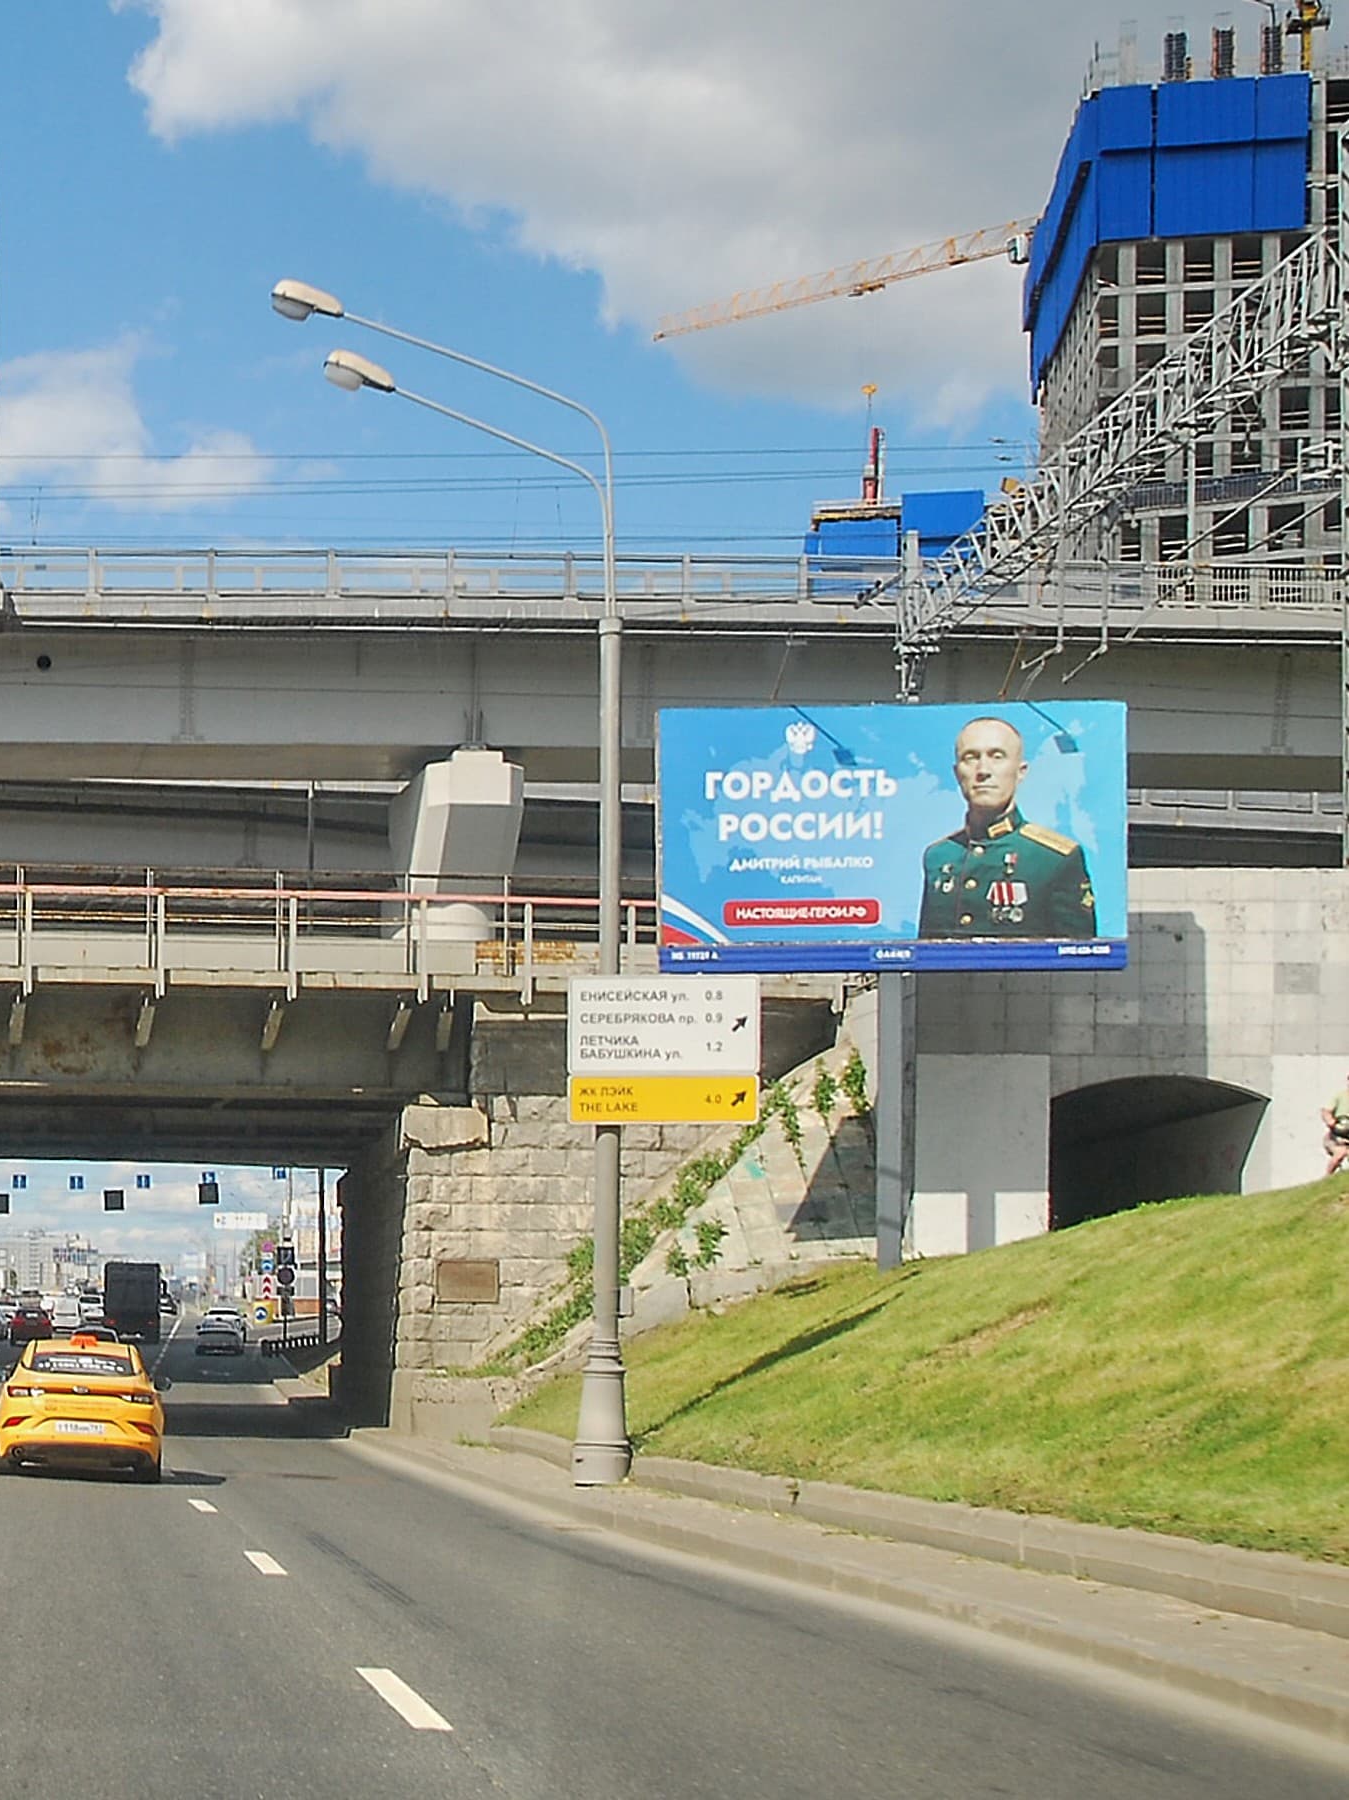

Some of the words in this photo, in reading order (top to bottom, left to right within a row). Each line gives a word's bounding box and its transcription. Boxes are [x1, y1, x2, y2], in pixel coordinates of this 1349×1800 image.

[705, 769, 898, 803] ГОРДОСТЬ
[718, 811, 884, 842] РОССИИ!
[729, 855, 800, 872] ДМИТРИЙ
[804, 856, 874, 870] РЫБАЛКО
[580, 989, 668, 1002] ЕНИСЕЙСКАЯ
[671, 991, 690, 1004] ул.
[705, 990, 723, 1001] 0.8
[580, 1013, 675, 1025] СЕРЕБРЯКОВА
[678, 1014, 698, 1026] пр.
[705, 1013, 723, 1024] 0.9
[580, 1035, 639, 1047] ЛЕТЧИКА
[706, 1042, 723, 1052] 1.2
[580, 1048, 661, 1060] БАБУШКИНА
[664, 1050, 683, 1062] ул.
[580, 1087, 597, 1097] ЖК
[601, 1085, 634, 1097] ЛЭЙК
[580, 1102, 602, 1113] THE
[606, 1102, 638, 1113] LAKE
